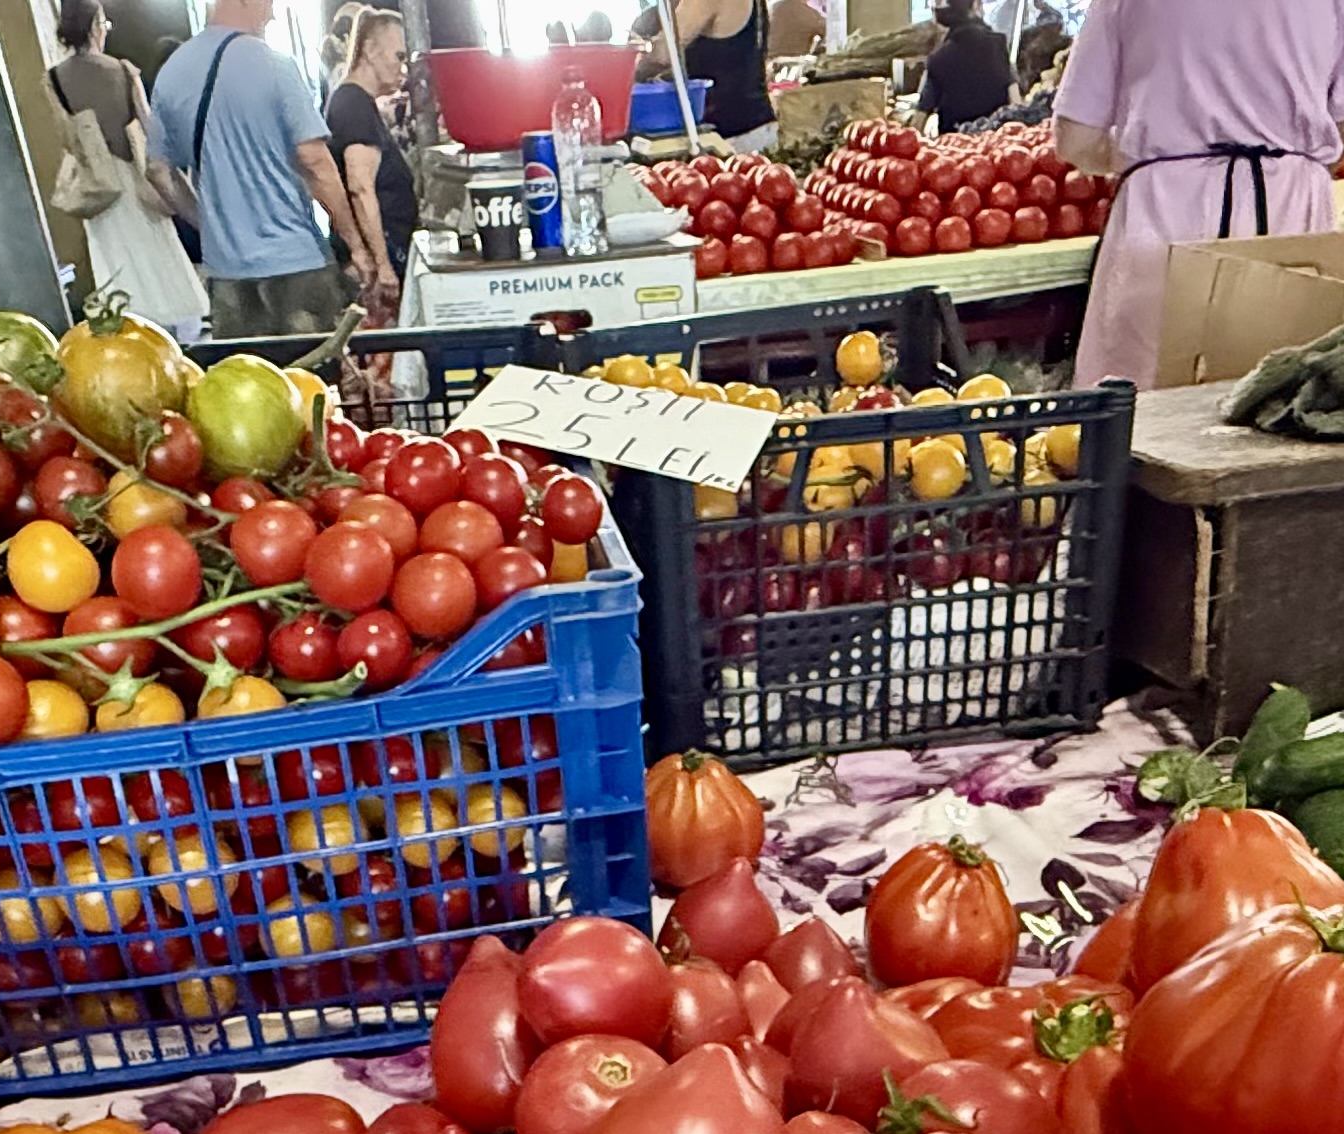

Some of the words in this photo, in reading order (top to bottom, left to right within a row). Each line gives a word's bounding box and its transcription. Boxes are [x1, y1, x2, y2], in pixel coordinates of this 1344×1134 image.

[524, 182, 556, 194] EPSI
[474, 196, 523, 228] offe
[489, 276, 573, 295] PREMIUM
[578, 271, 625, 289] PACK
[482, 400, 610, 449] 25
